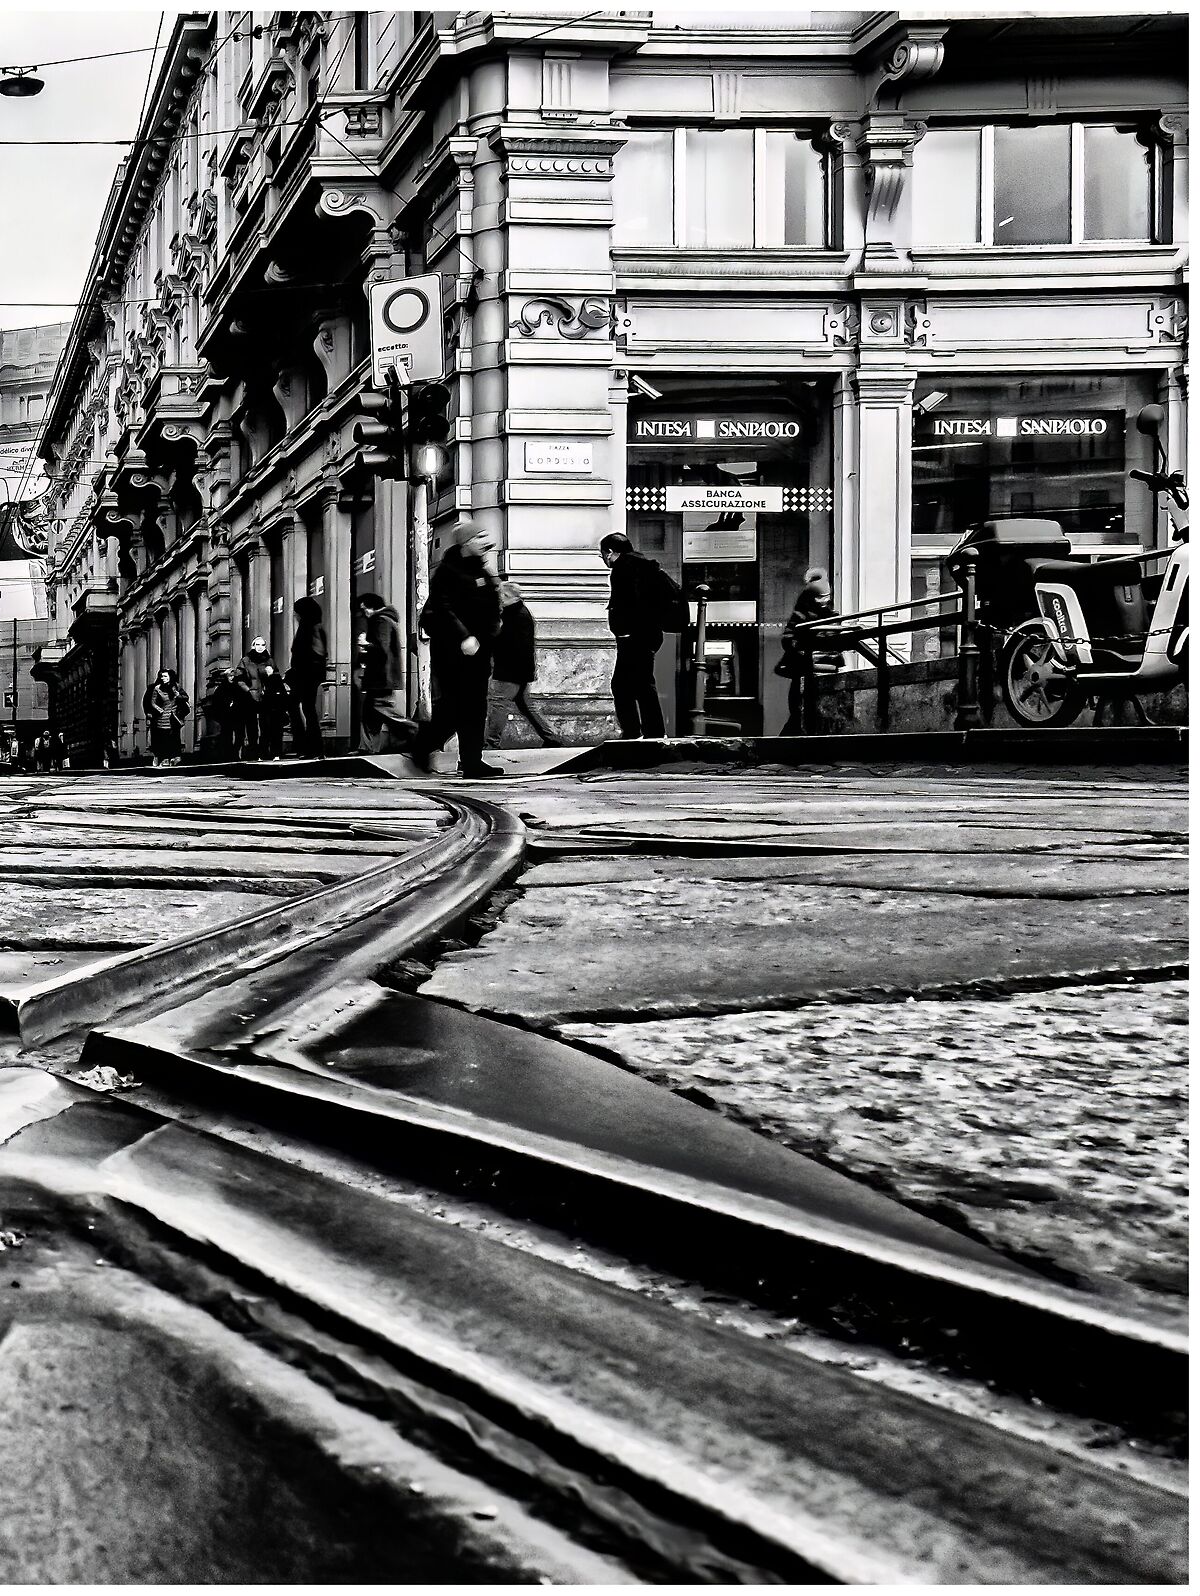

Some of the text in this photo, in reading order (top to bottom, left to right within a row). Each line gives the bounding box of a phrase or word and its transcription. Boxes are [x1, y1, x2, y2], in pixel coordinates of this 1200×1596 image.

[636, 420, 800, 438] INTESA SANPAOLO
[934, 419, 1107, 436] INTESA SANPAOLO
[528, 457, 590, 465] CORDUSO
[706, 490, 742, 498] BANCA
[681, 500, 766, 508] ASSICURAZIONE
